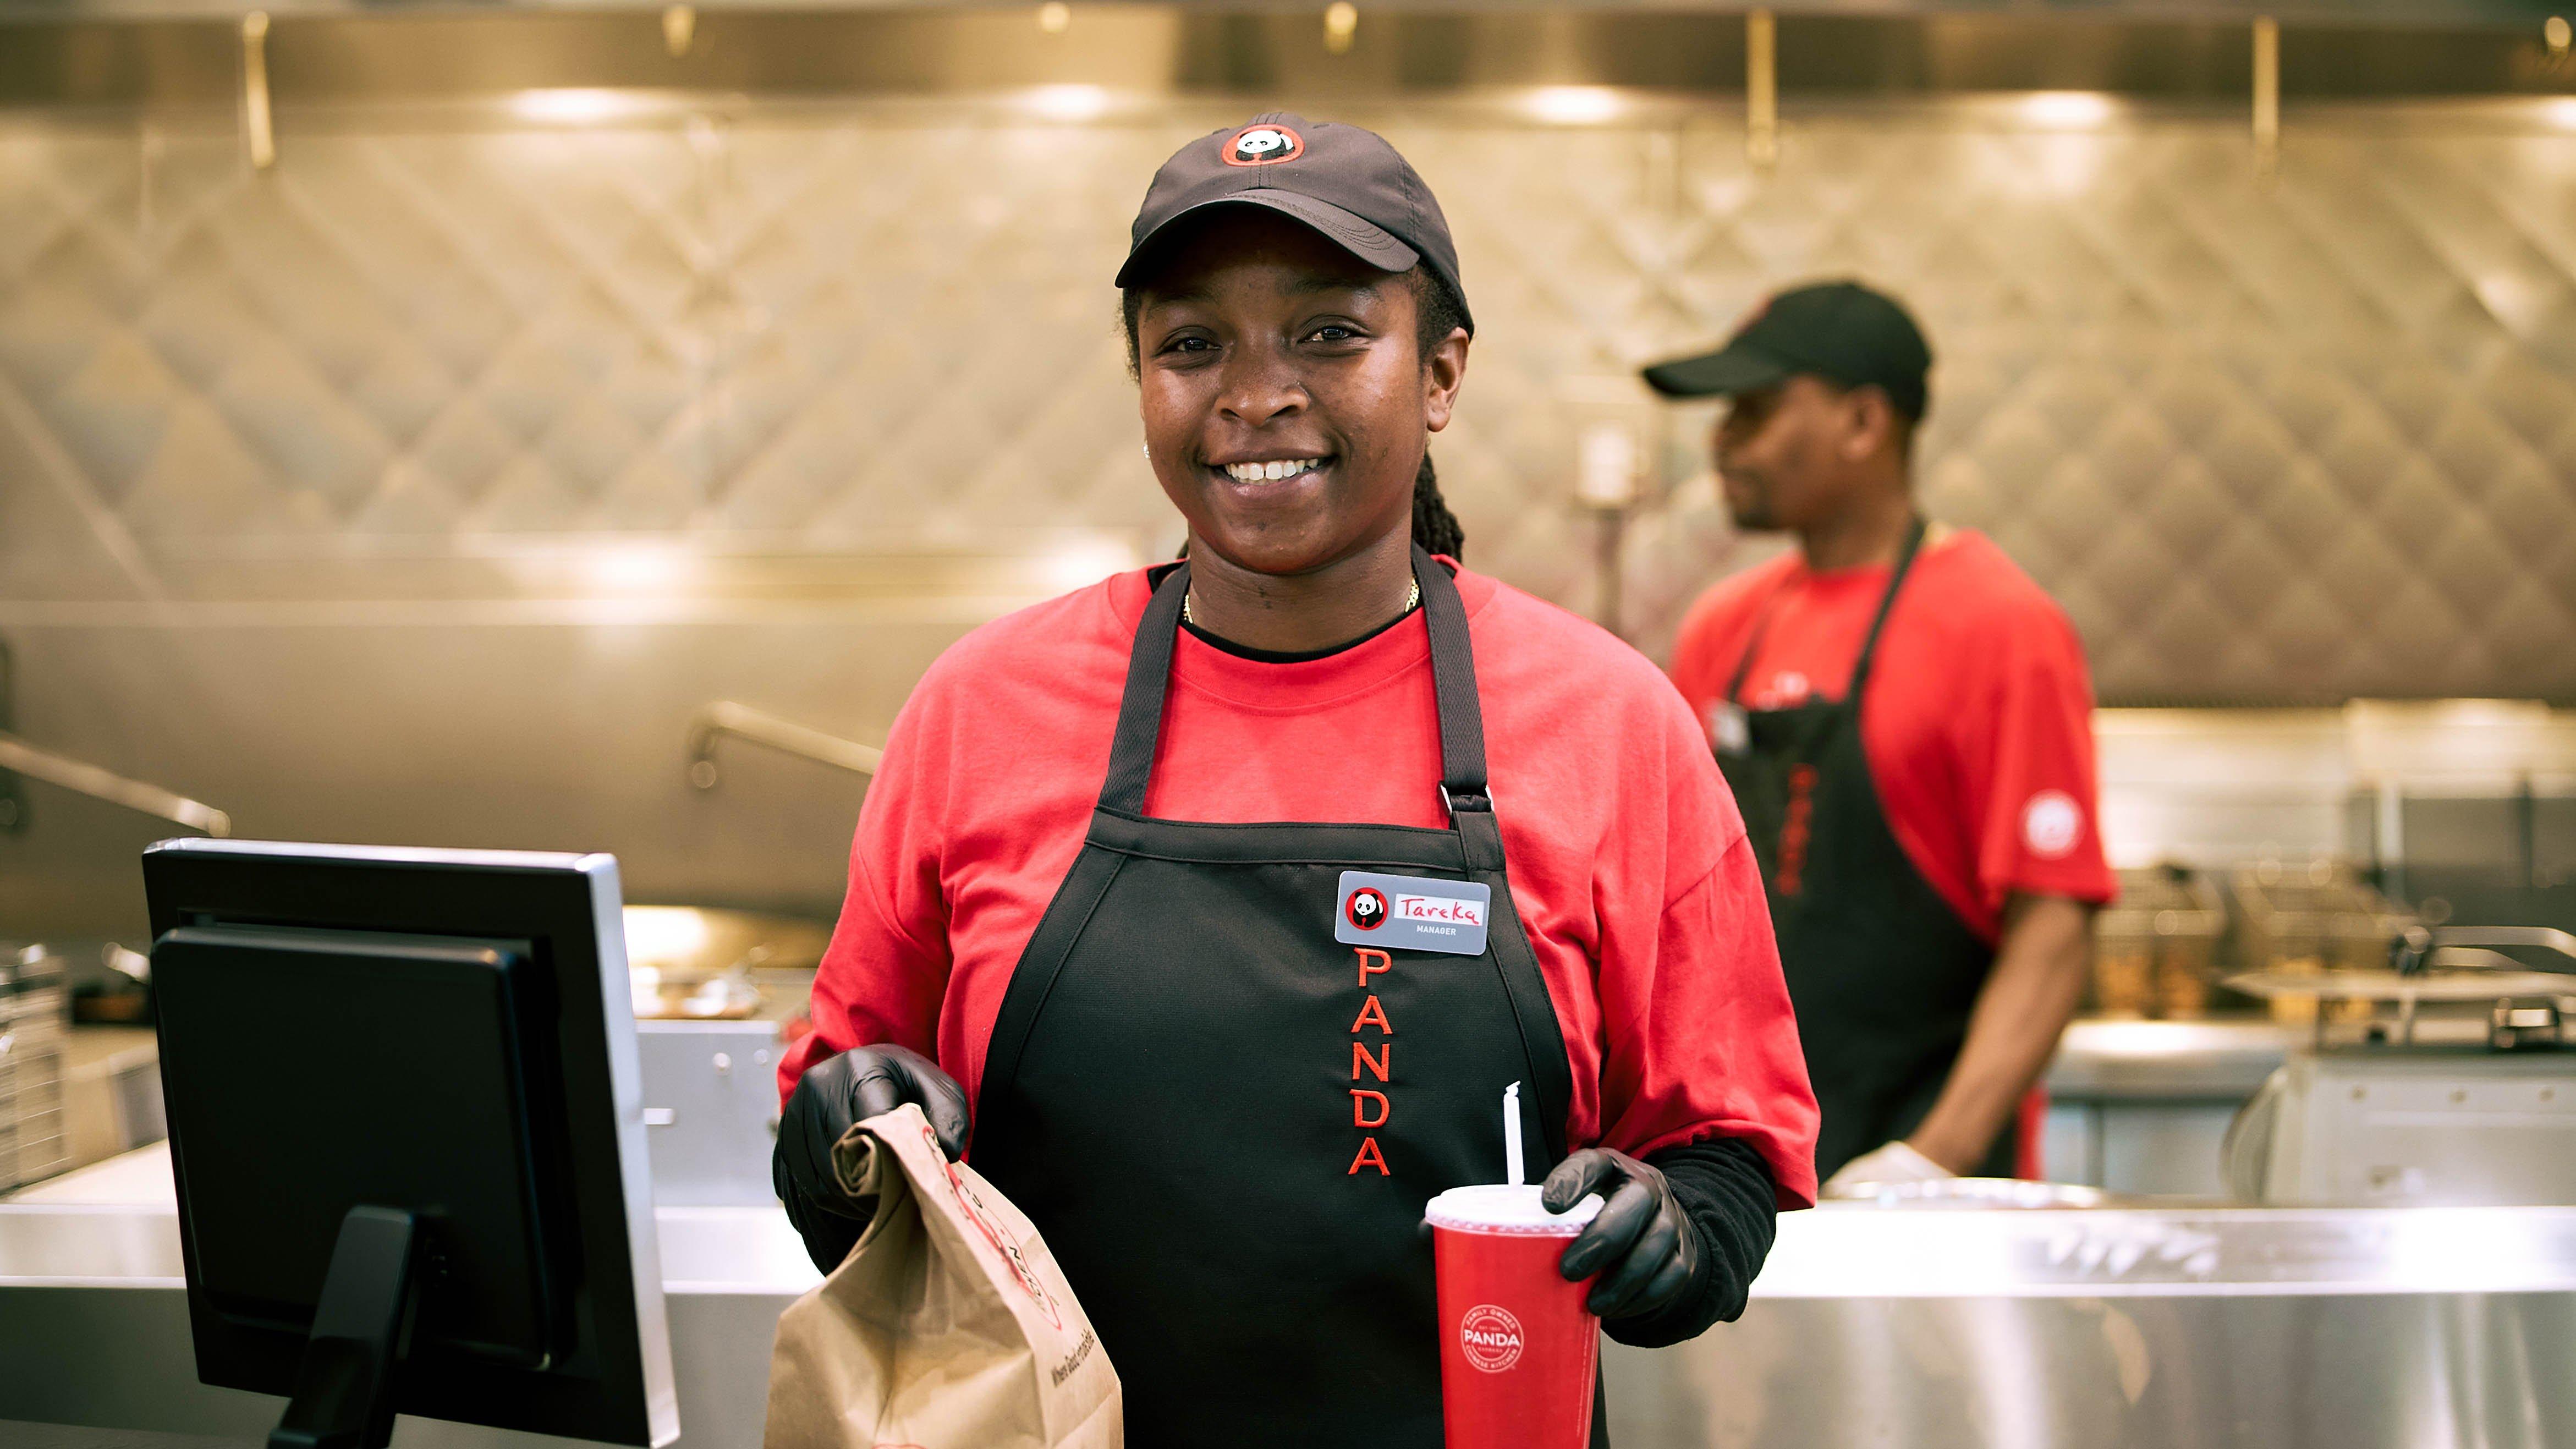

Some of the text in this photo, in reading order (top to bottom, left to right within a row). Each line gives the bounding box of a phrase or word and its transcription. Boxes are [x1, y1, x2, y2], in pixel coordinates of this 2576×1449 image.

[1416, 925, 1457, 936] MANAGER
[1348, 947, 1393, 1176] PANDA
[1464, 1329, 1521, 1347] PANDA
